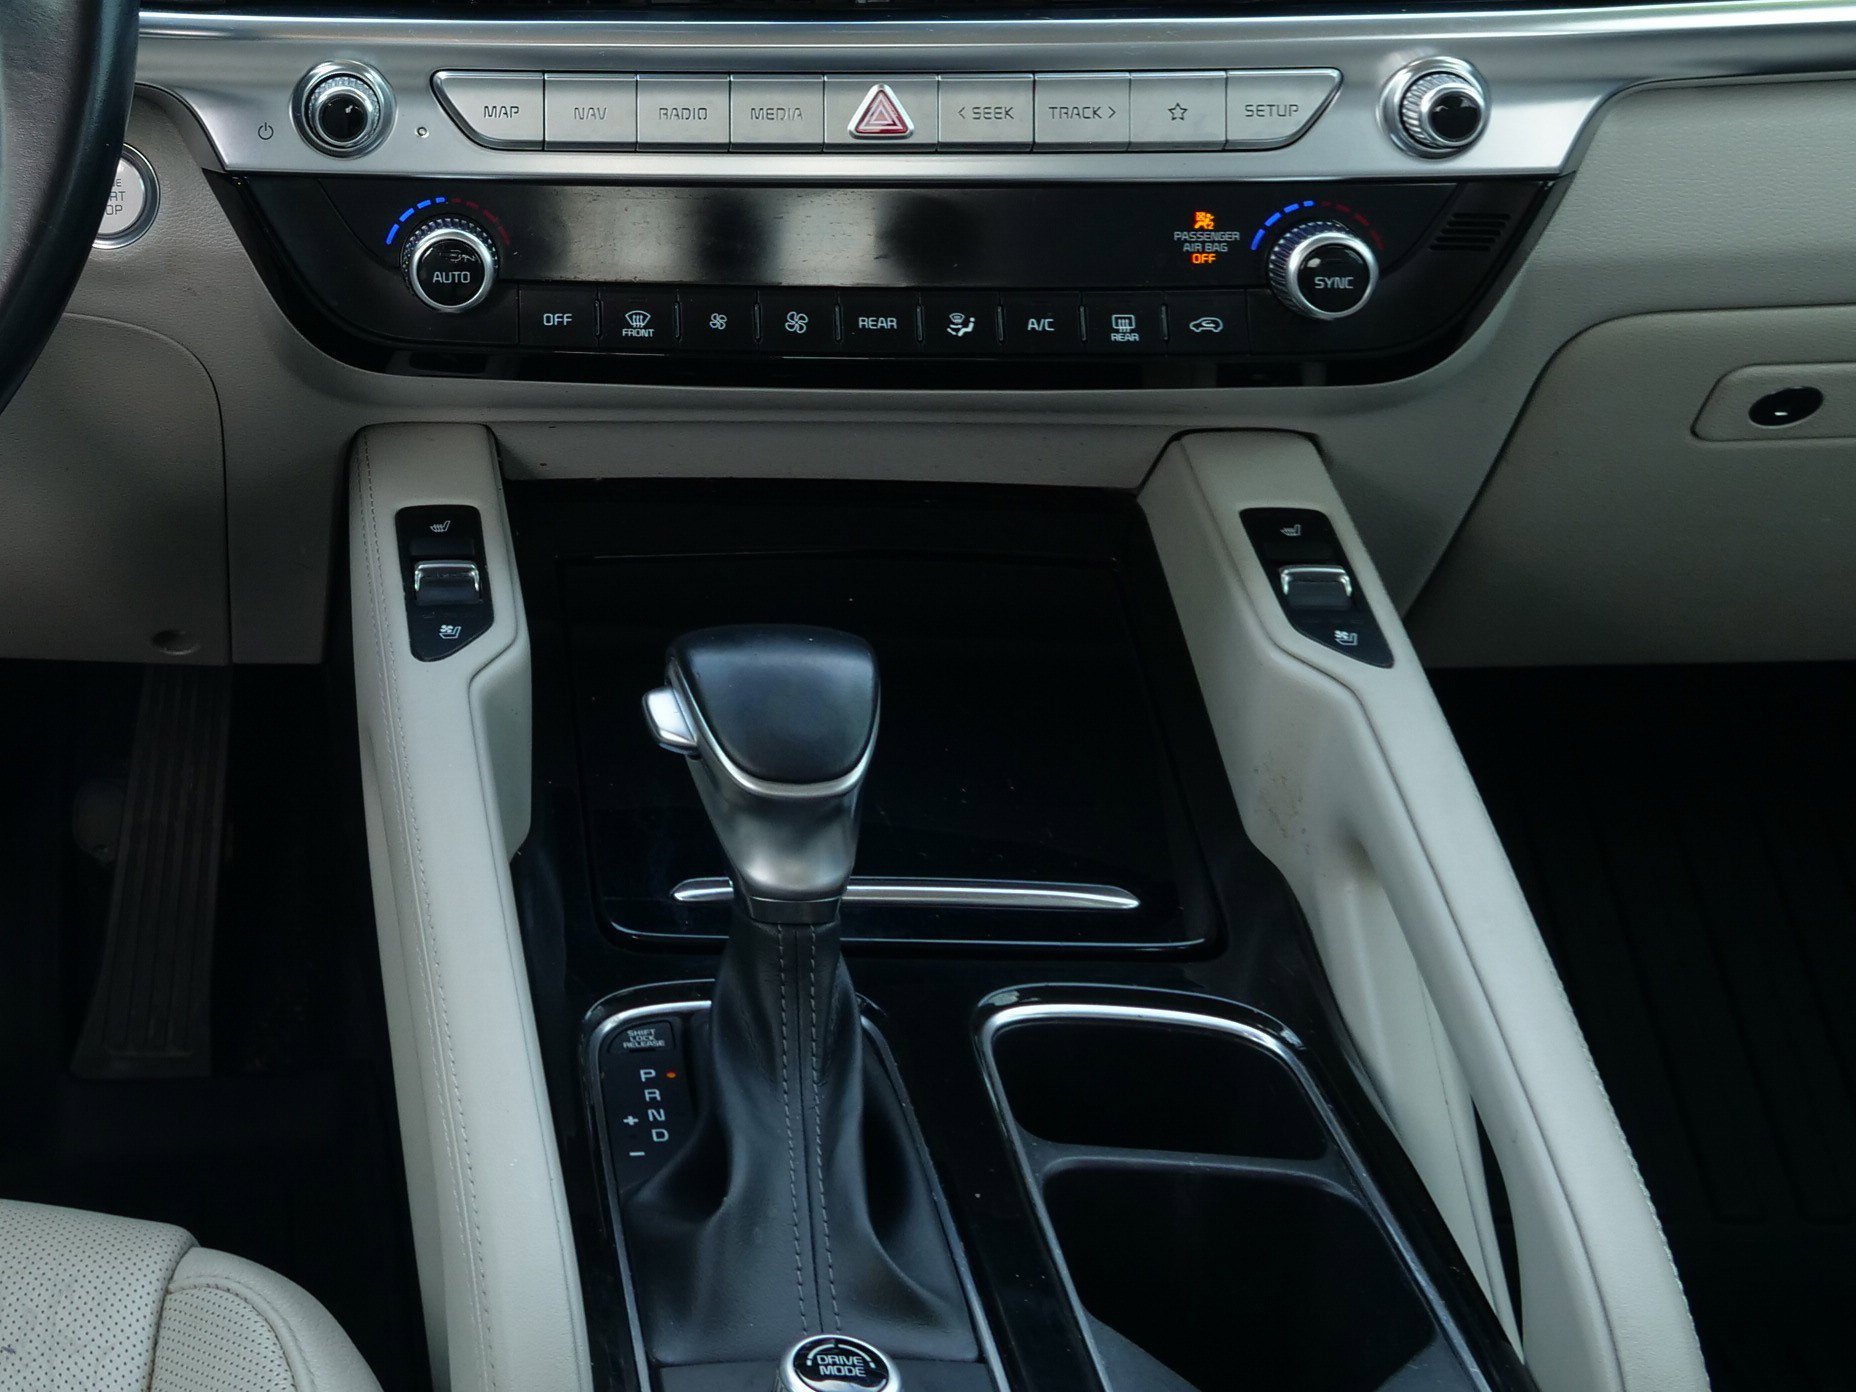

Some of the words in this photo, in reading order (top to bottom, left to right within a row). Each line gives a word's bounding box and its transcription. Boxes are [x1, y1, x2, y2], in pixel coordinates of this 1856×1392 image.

[483, 105, 520, 119] MAP
[573, 106, 608, 120] NAV
[658, 107, 708, 121] RADIO
[750, 106, 804, 121] MEDIA
[971, 106, 1015, 120] SEEK
[1049, 106, 1102, 120] TRACK
[1244, 103, 1300, 119] SETUP
[1173, 231, 1241, 242] PASSENGER
[1183, 242, 1203, 253] AIR
[1205, 242, 1229, 253] BAG
[1191, 253, 1217, 264] OFF
[432, 271, 471, 285] AUTO
[1314, 276, 1355, 290] SYNC
[543, 312, 573, 326] OFF
[858, 316, 898, 330] REAR
[1027, 317, 1054, 333] A/C
[622, 327, 655, 338] FRONT
[1110, 331, 1140, 343] REAR
[626, 1028, 656, 1037] SHIFT
[630, 1034, 656, 1042] LOCK
[622, 1040, 666, 1049] RELEASE
[639, 1069, 656, 1082] P
[644, 1089, 661, 1102] R
[647, 1108, 666, 1122] N
[651, 1128, 669, 1142] D
[816, 1354, 864, 1366] DRIVE
[819, 1365, 867, 1377] MODE
